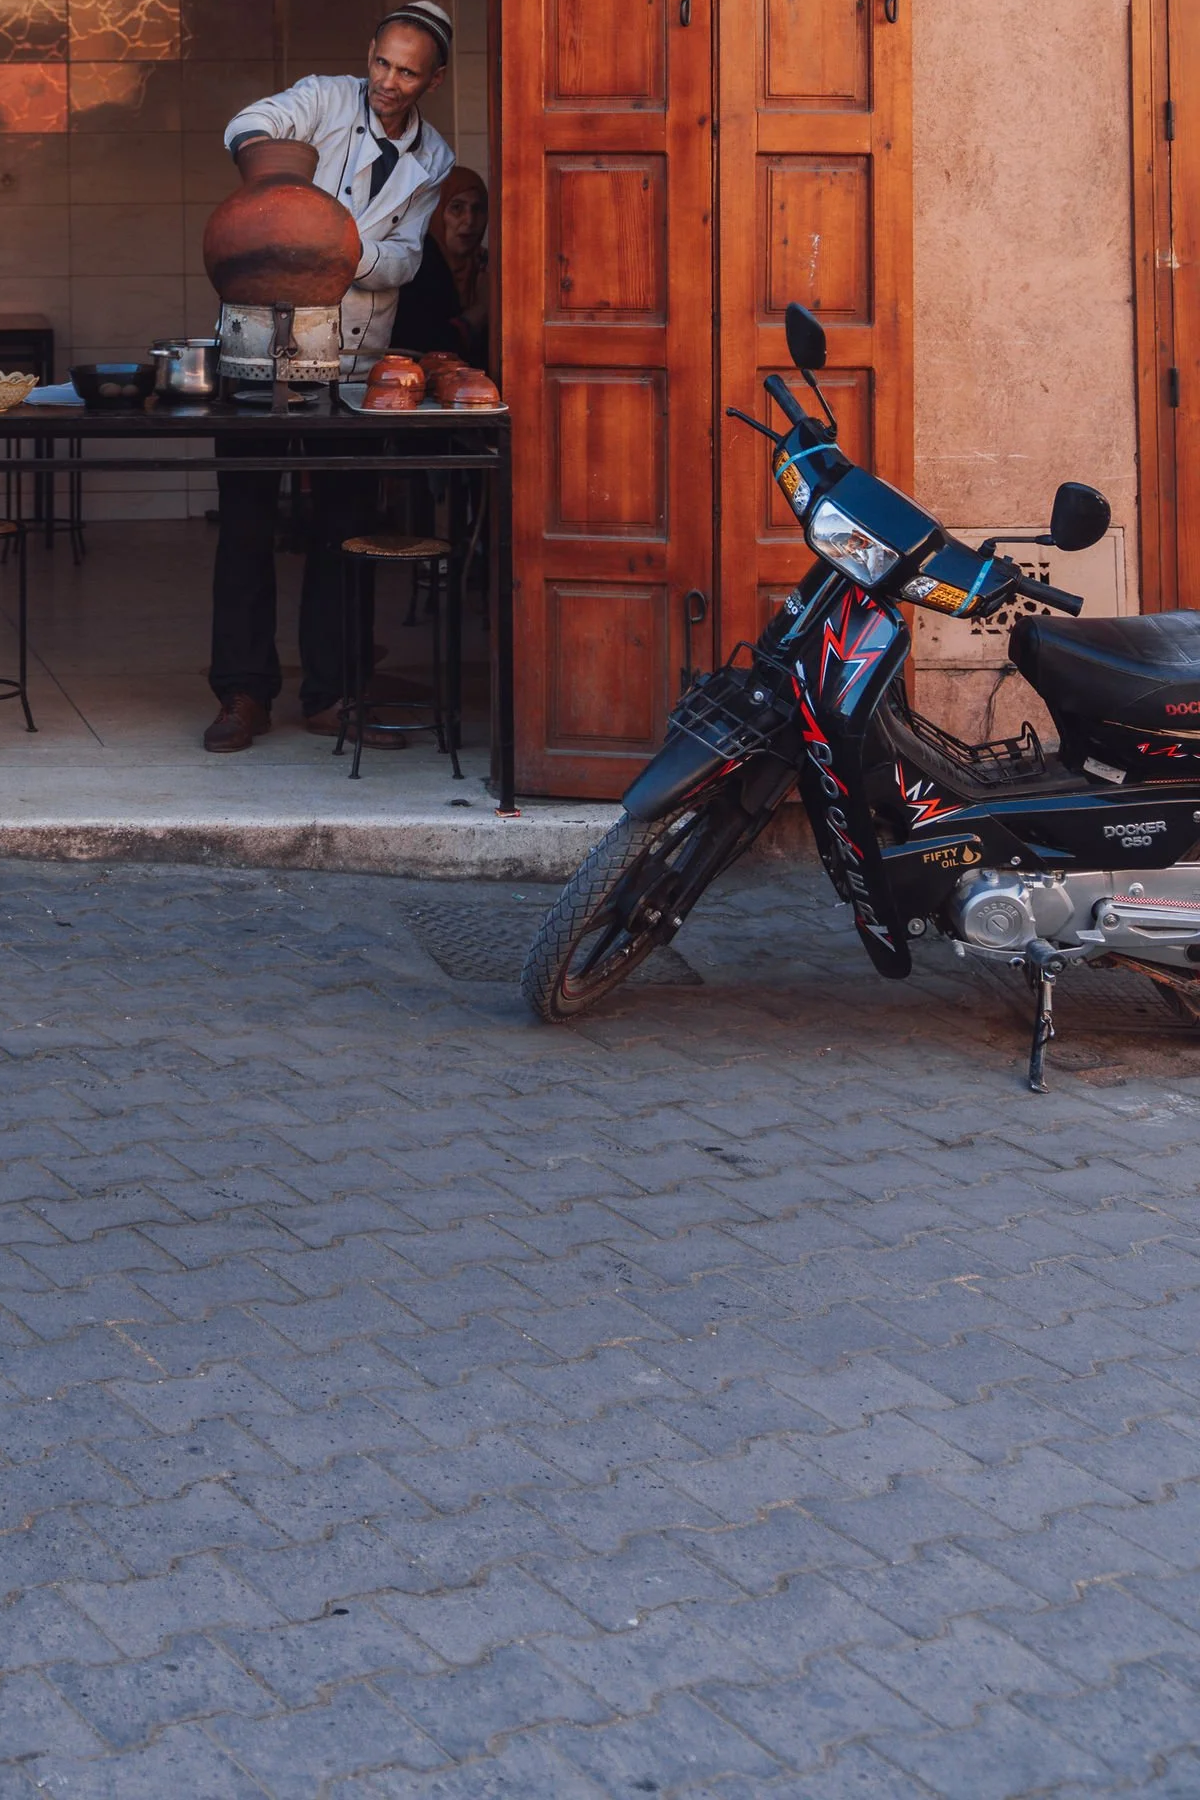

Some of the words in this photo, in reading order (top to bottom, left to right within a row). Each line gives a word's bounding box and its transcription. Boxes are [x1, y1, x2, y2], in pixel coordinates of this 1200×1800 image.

[812, 740, 880, 926] DOCKER
[1103, 820, 1168, 839] DOCKER
[1121, 835, 1152, 848] C50
[923, 847, 958, 864] FIFTY
[941, 858, 959, 869] OIL
